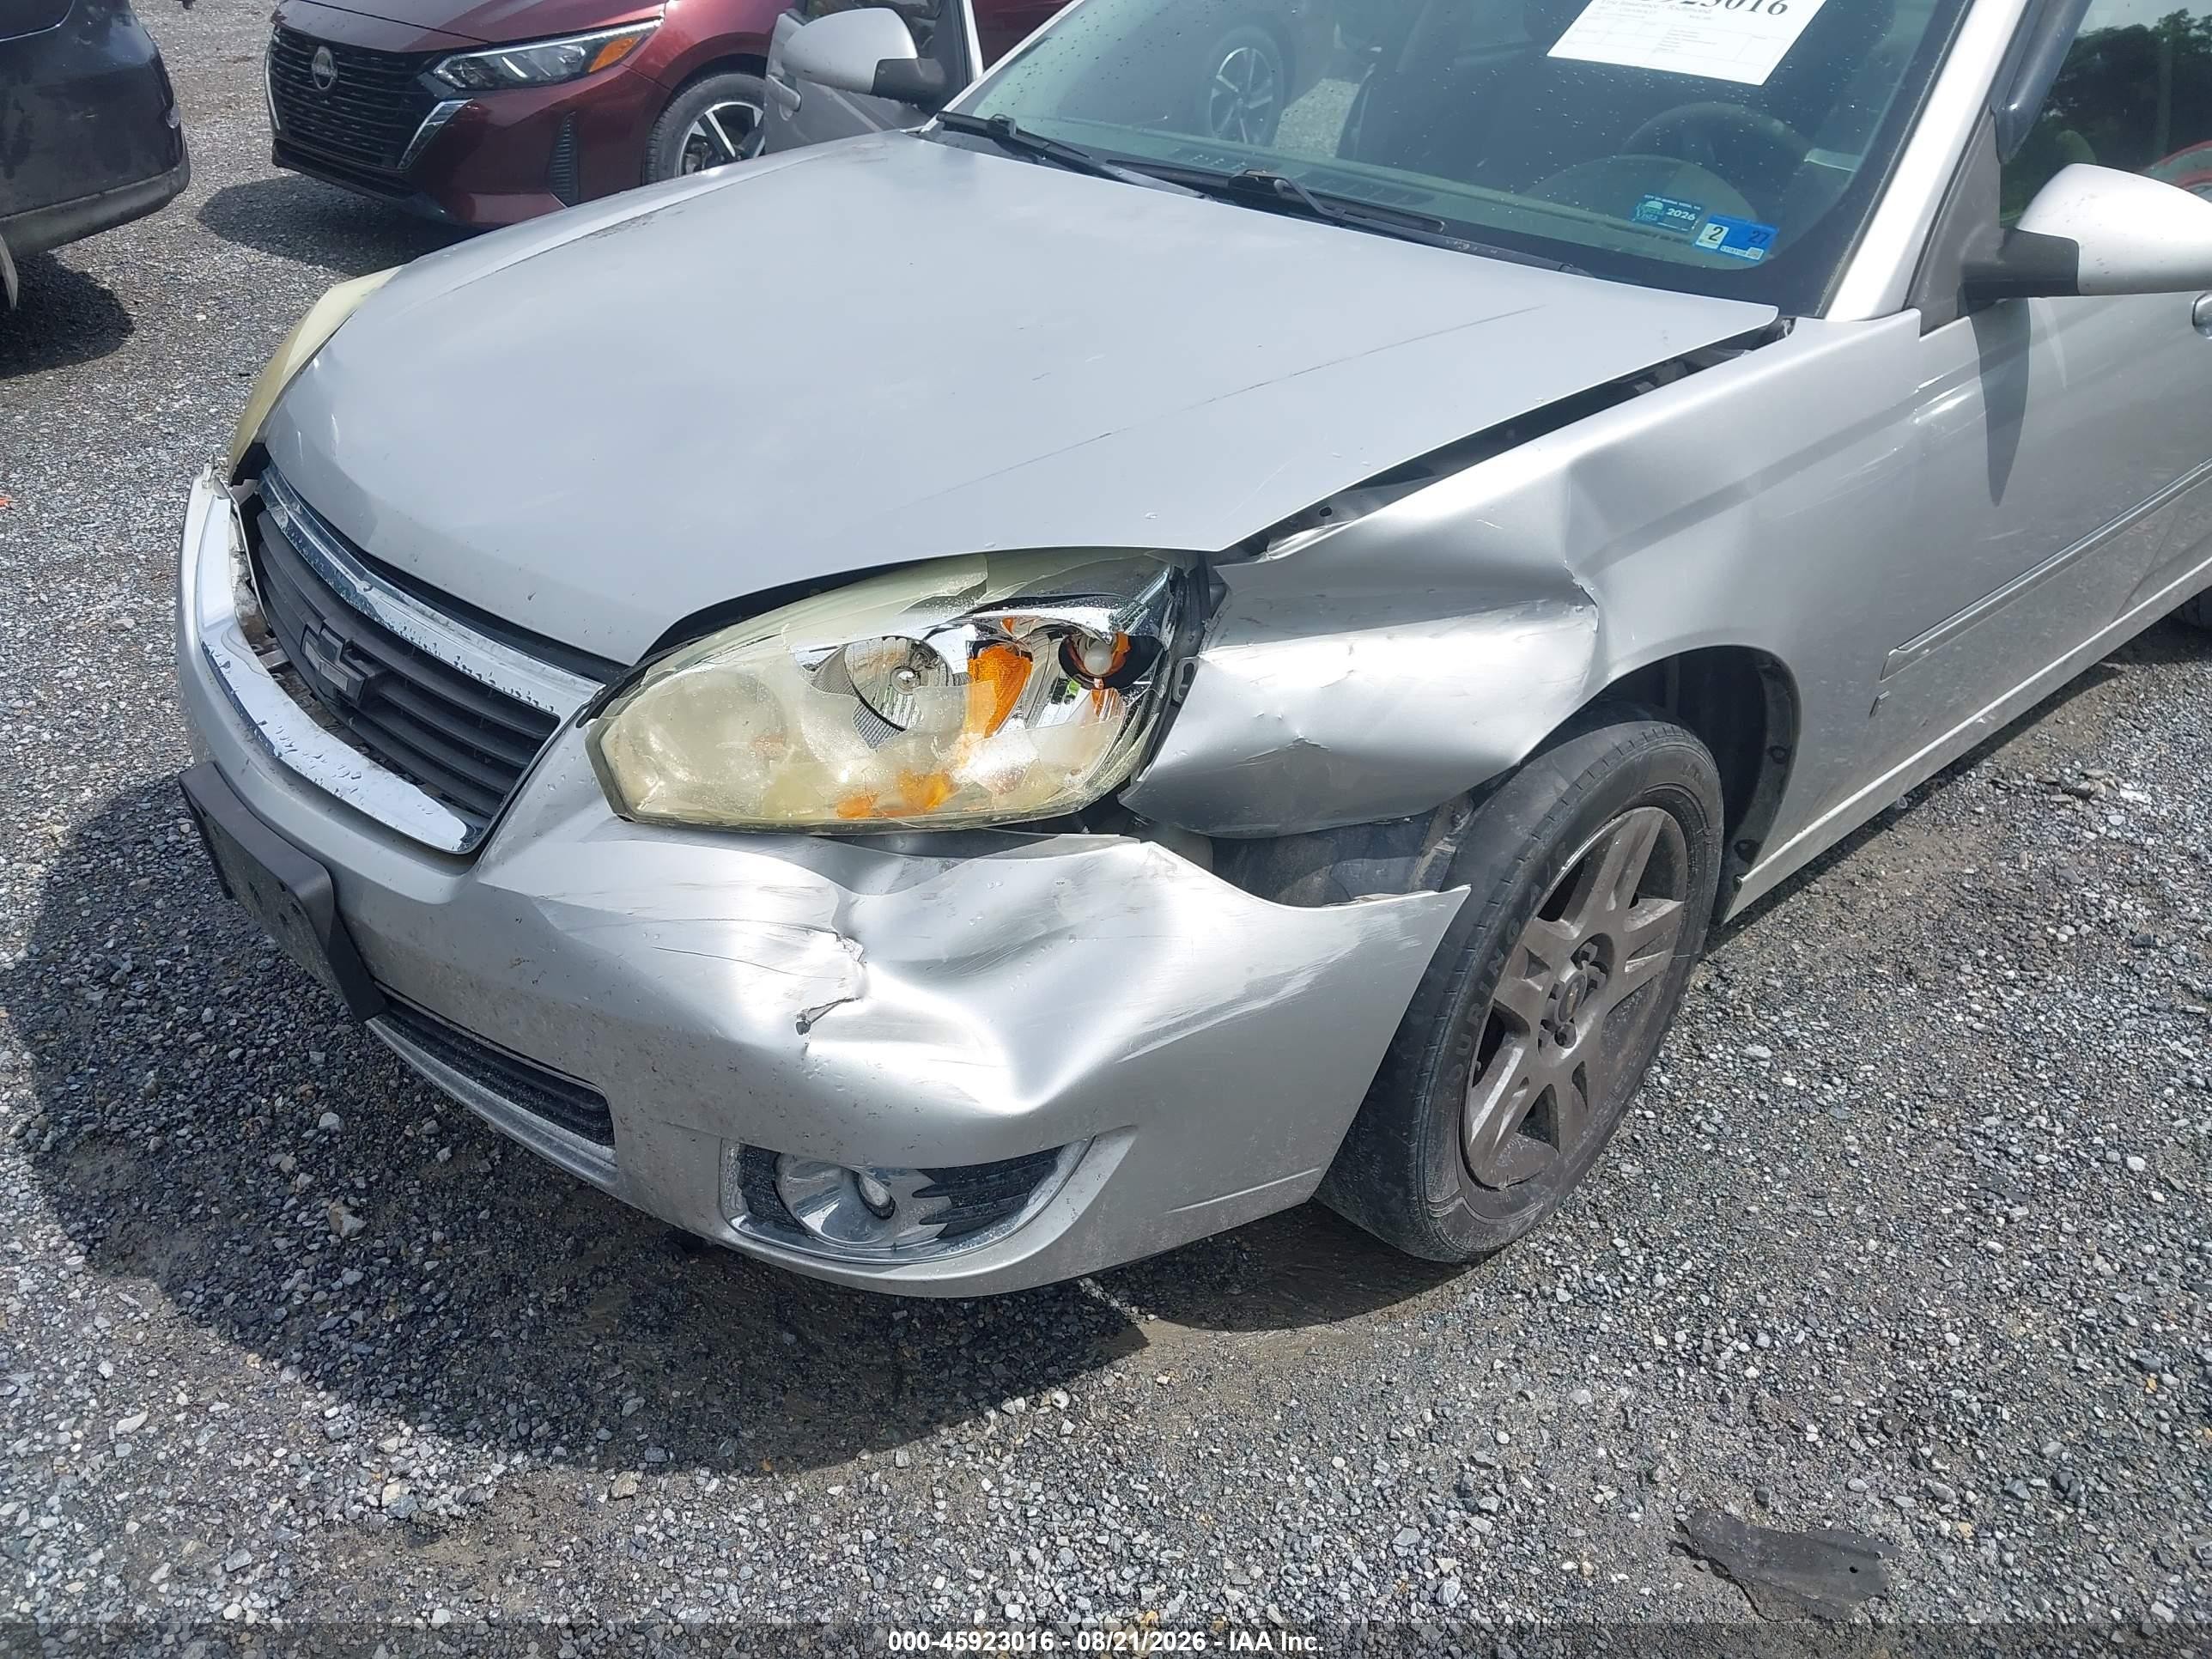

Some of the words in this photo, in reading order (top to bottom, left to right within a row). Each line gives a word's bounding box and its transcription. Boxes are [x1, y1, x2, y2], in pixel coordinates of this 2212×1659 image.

[1666, 208, 1697, 221] 2026
[1709, 226, 1723, 241] 2
[1747, 229, 1770, 245] 27
